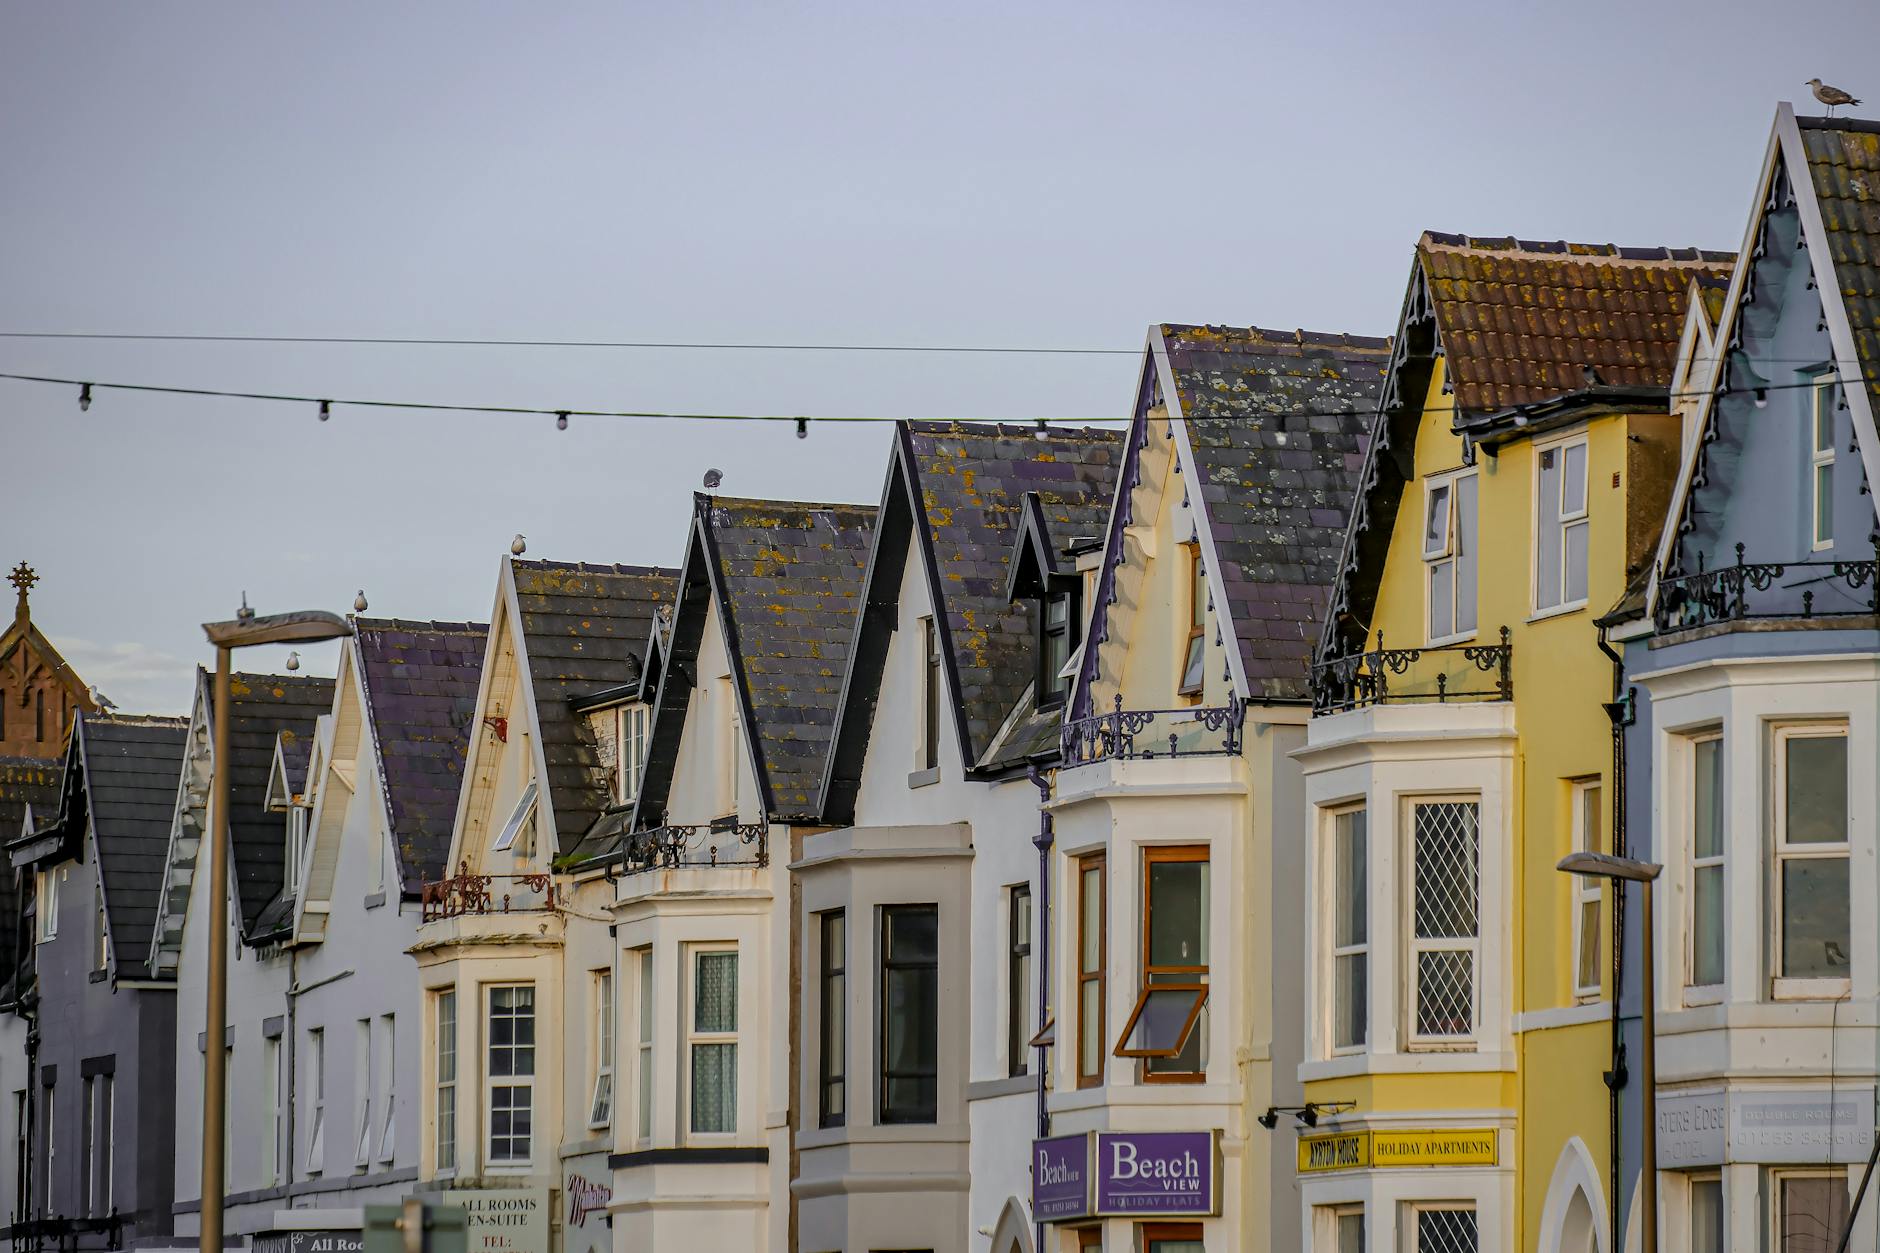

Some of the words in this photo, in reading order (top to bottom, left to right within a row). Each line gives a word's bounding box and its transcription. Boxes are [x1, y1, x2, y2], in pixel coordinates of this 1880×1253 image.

[1659, 1110, 1690, 1134] ATERS
[1337, 1136, 1360, 1165] HOUSE
[1377, 1141, 1422, 1156] HOLIDAY
[1424, 1140, 1492, 1155] APARTMENTS
[1039, 1149, 1068, 1186] Beach
[1110, 1141, 1200, 1180] Beach
[1162, 1179, 1200, 1191] VIEW
[488, 1198, 537, 1212] ROOMS
[1108, 1196, 1161, 1207] HOLIDAY
[1166, 1195, 1200, 1207] FLATS
[467, 1213, 528, 1227] EN-SUITE
[311, 1239, 333, 1252] All
[337, 1240, 366, 1251] Roo
[482, 1235, 513, 1248] TEL:
